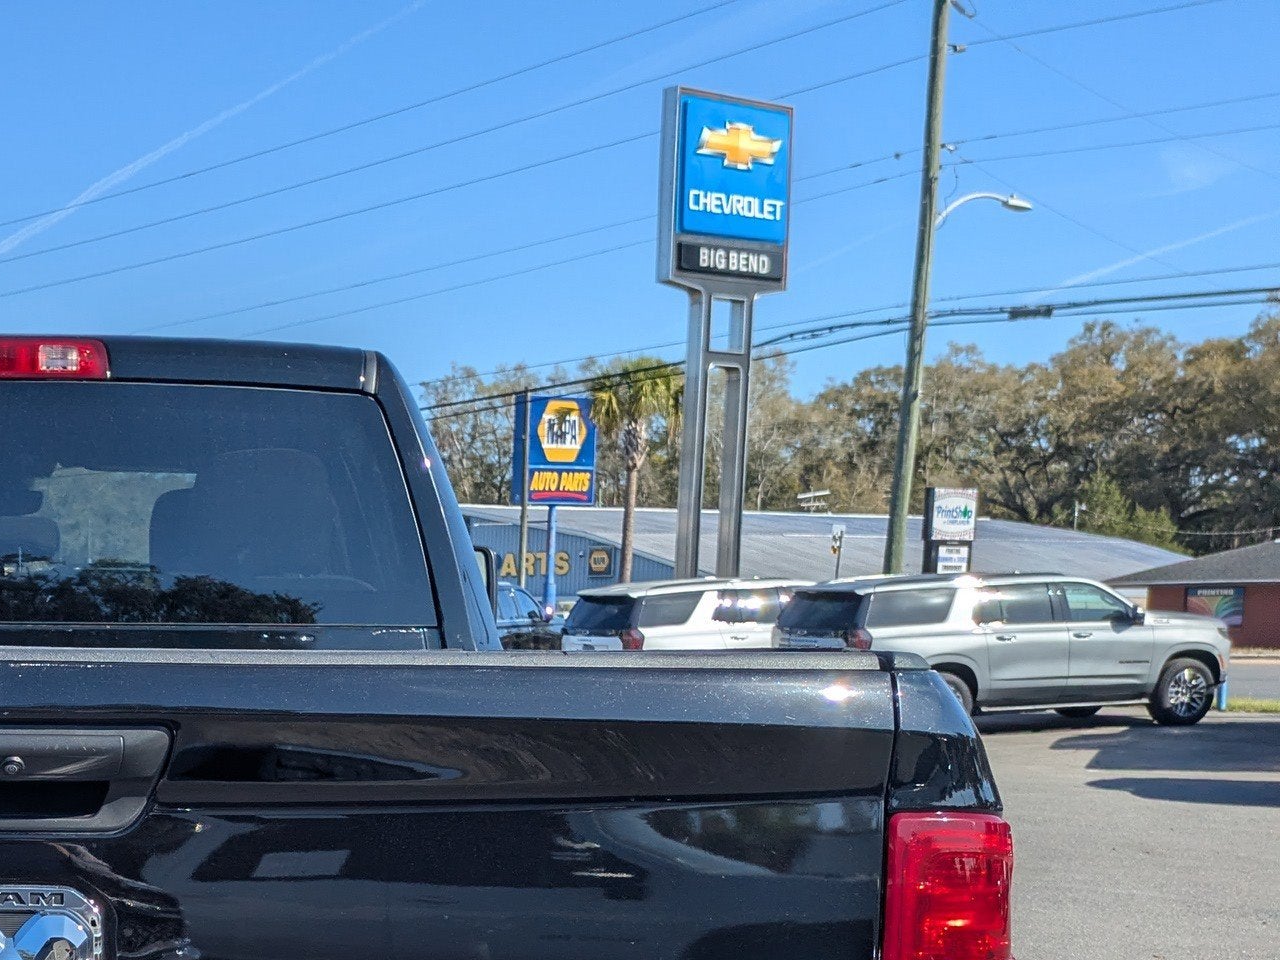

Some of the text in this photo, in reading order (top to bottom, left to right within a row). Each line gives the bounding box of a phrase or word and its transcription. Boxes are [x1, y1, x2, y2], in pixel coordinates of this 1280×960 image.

[689, 189, 785, 221] CHEVROLET
[699, 246, 770, 274] BIG BEND
[547, 418, 577, 445] NAPA
[530, 471, 591, 492] AUTO PARTS
